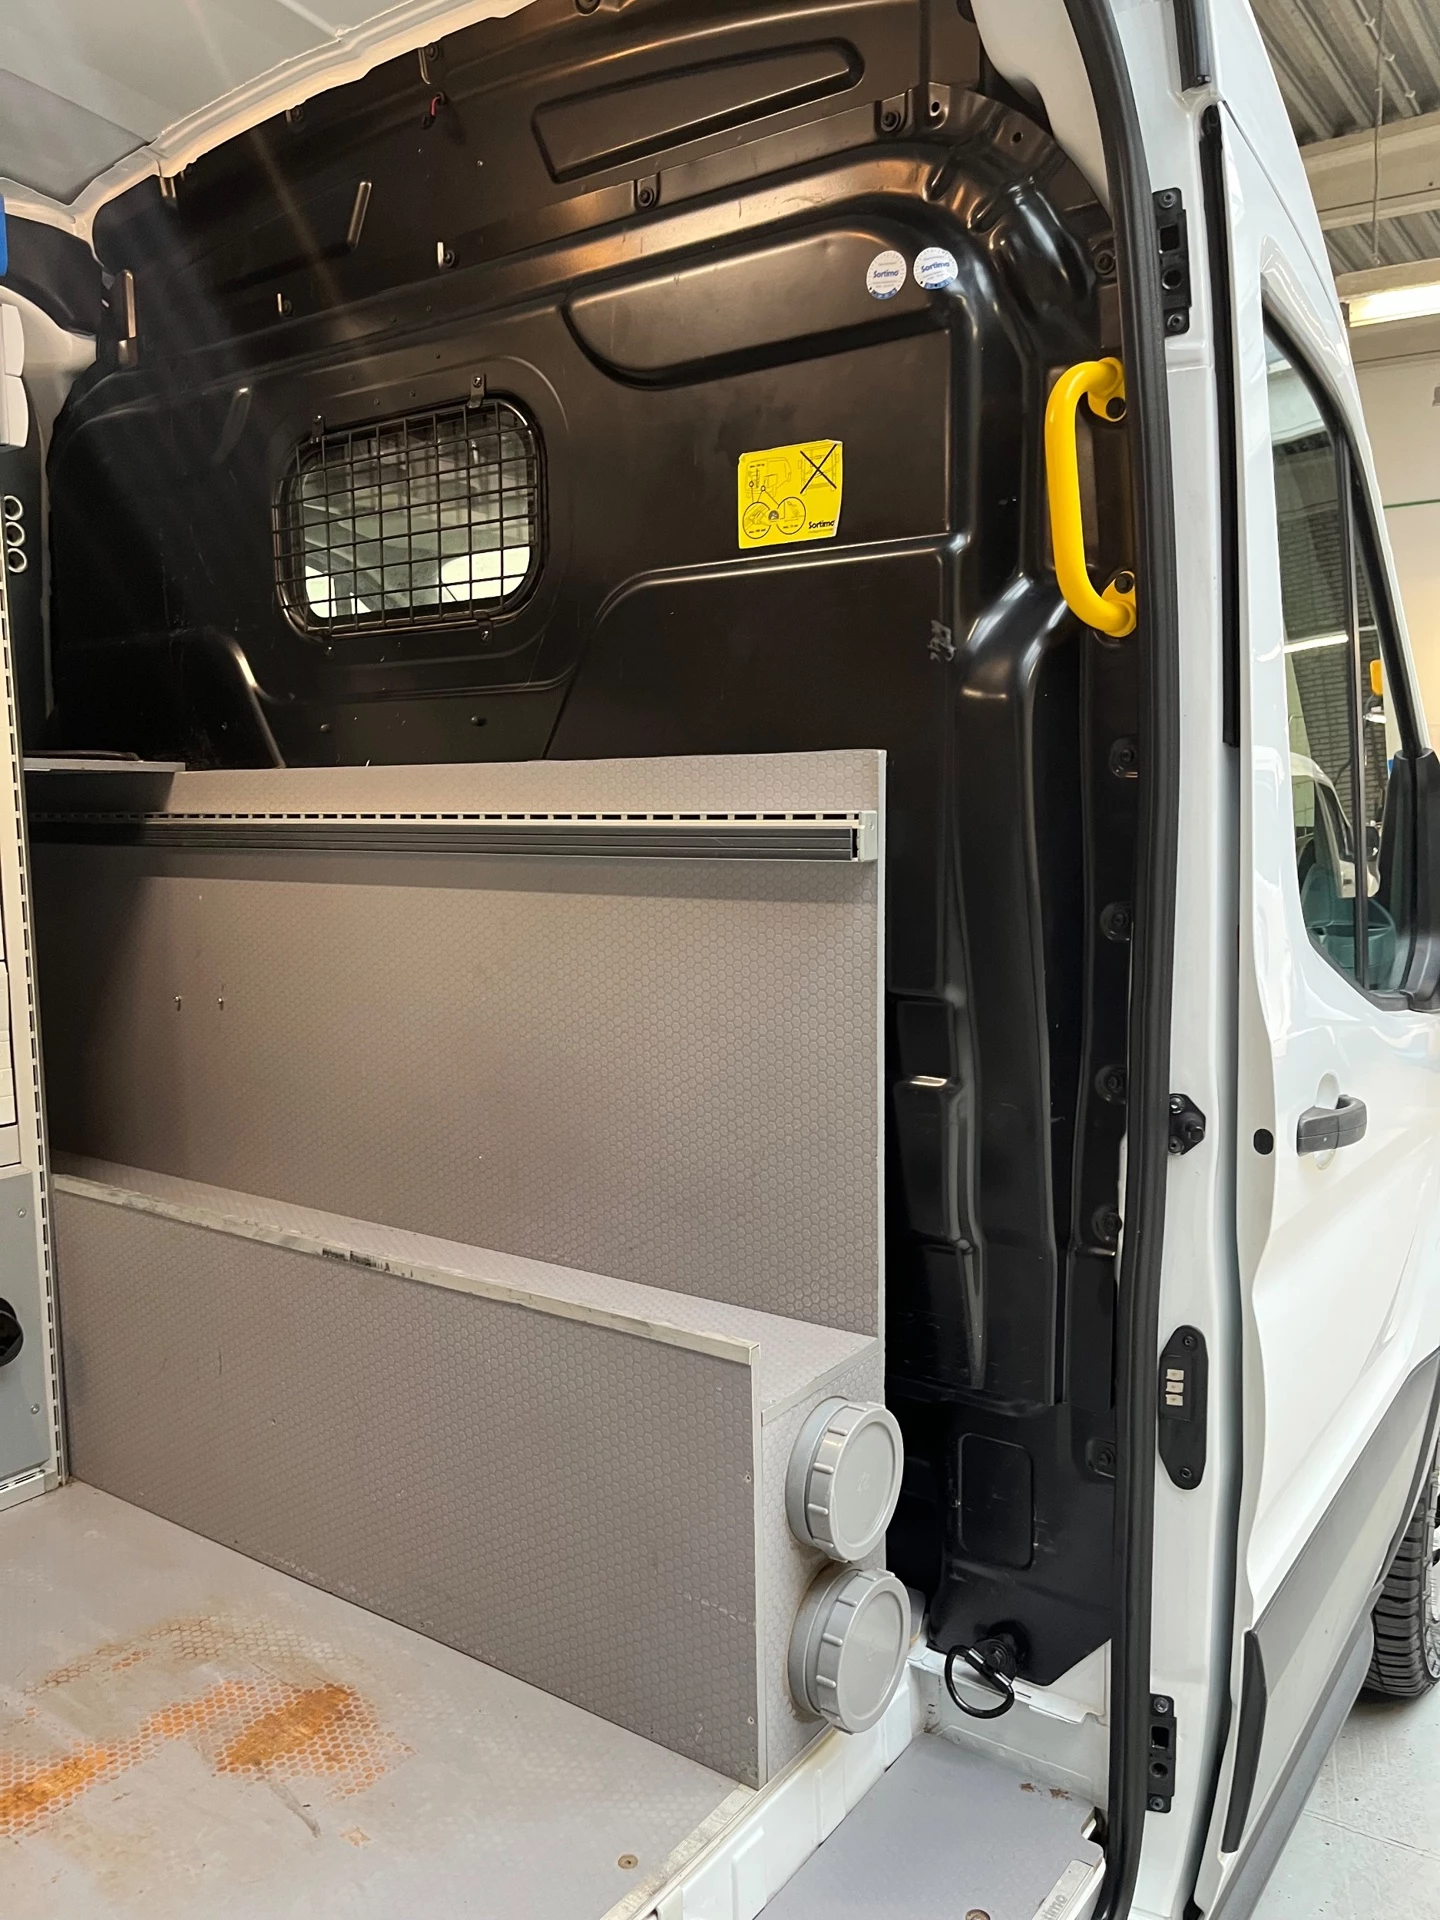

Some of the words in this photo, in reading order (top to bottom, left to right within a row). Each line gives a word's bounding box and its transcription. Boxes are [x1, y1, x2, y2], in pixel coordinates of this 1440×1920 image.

[921, 261, 950, 272] Sortimo
[873, 269, 899, 278] Sortimo
[808, 519, 835, 529] Sortimo
